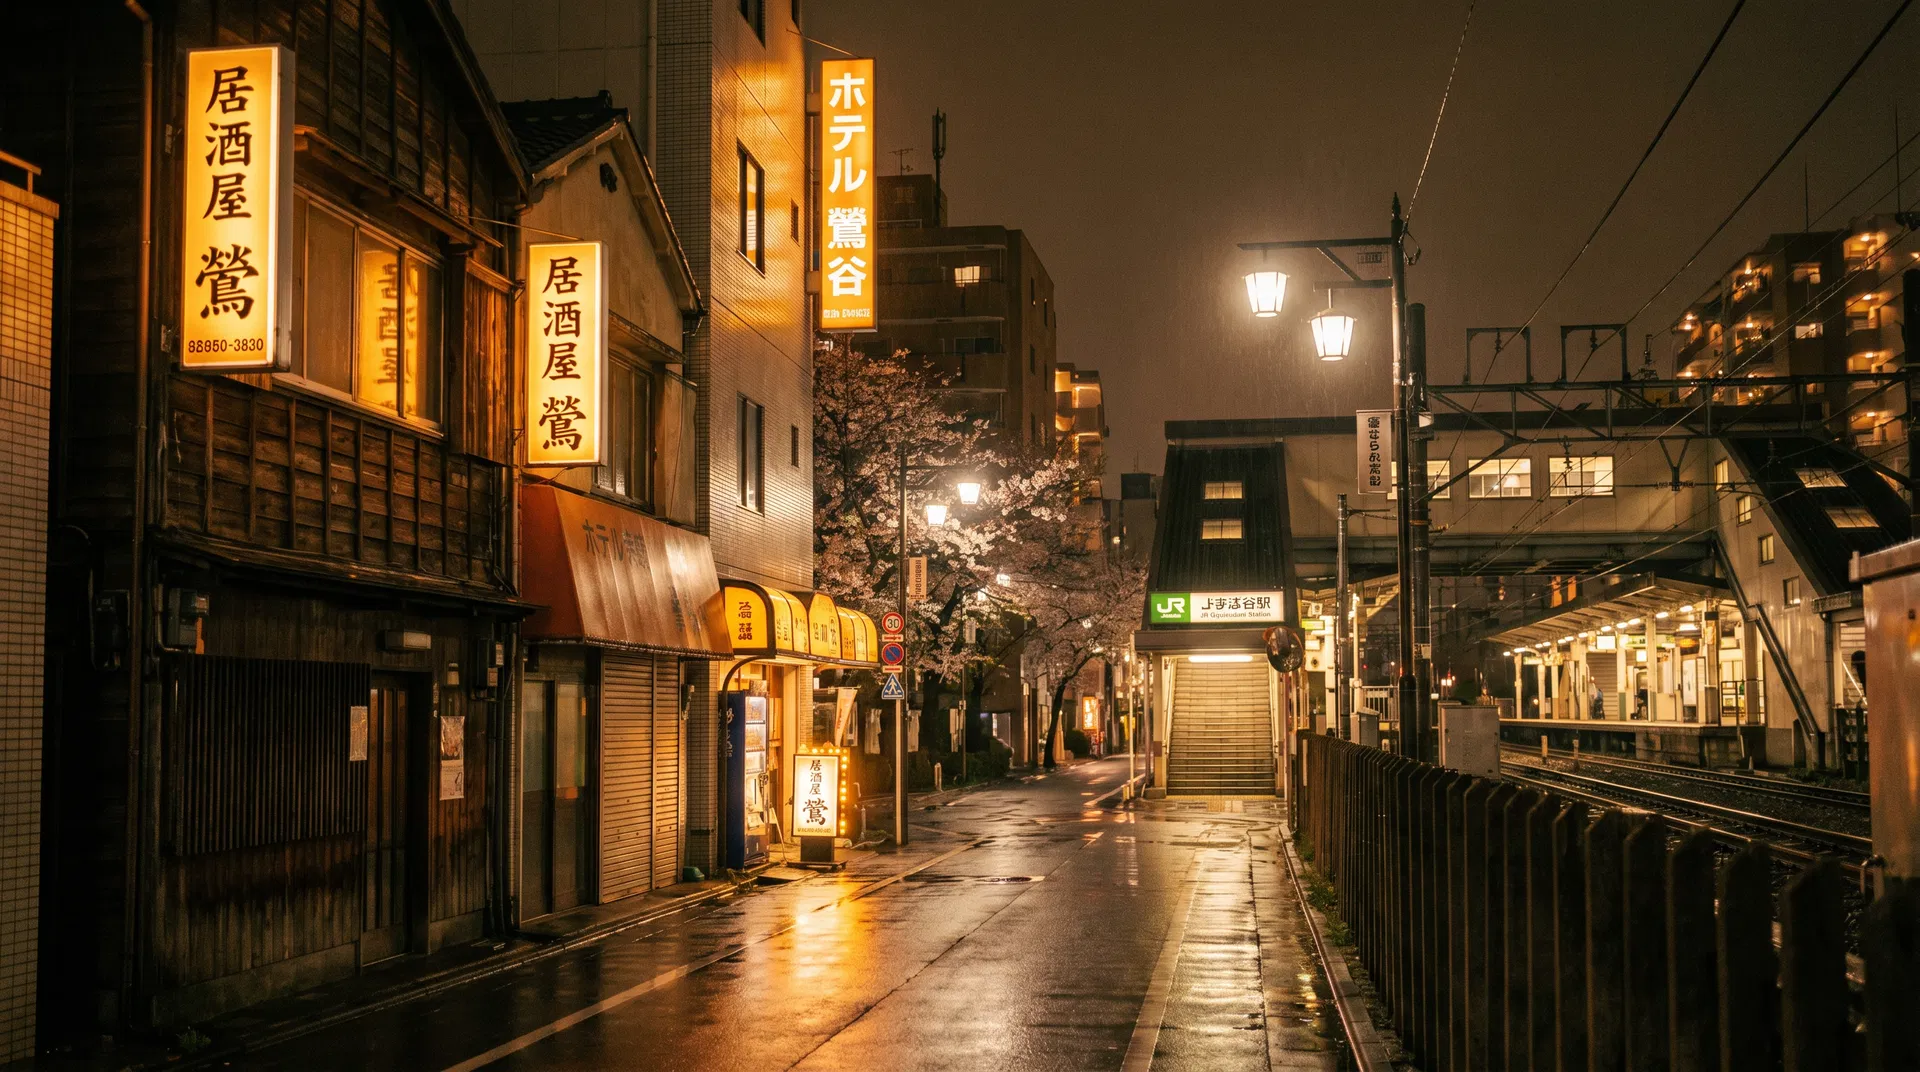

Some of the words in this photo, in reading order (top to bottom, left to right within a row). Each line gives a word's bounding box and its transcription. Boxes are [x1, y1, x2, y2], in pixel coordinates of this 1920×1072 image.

[203, 65, 254, 221] 居酒屋
[828, 72, 867, 194] ホテル
[541, 256, 583, 381] 居酒屋
[887, 619, 900, 629] 30
[1156, 597, 1186, 613] JR
[809, 759, 823, 795] 居酒屋
